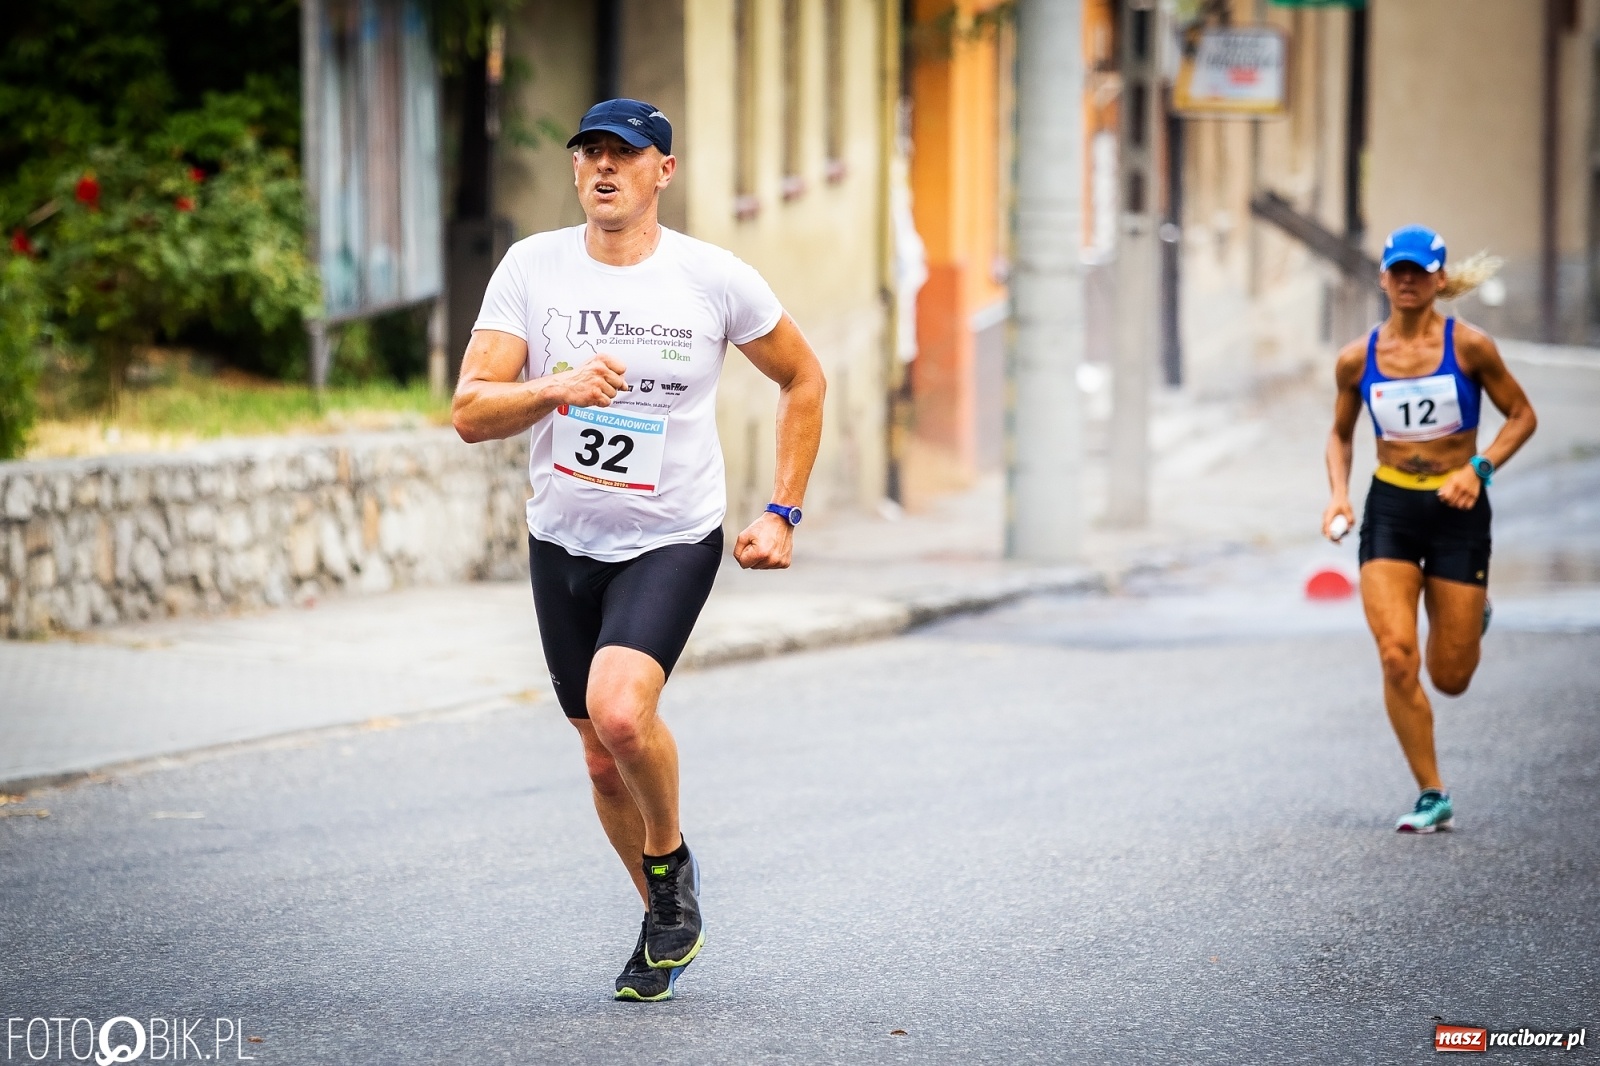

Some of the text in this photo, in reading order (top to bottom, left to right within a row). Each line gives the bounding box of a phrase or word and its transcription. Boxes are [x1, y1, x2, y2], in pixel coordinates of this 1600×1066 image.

[627, 117, 643, 127] 4F
[577, 310, 692, 339] IV Eko-Cross
[609, 337, 634, 345] Ziemi
[636, 337, 692, 349] Pietrowickiej
[569, 407, 660, 432] I BIEG KRZANOWICKI
[1398, 399, 1437, 428] 12
[575, 428, 634, 474] 32
